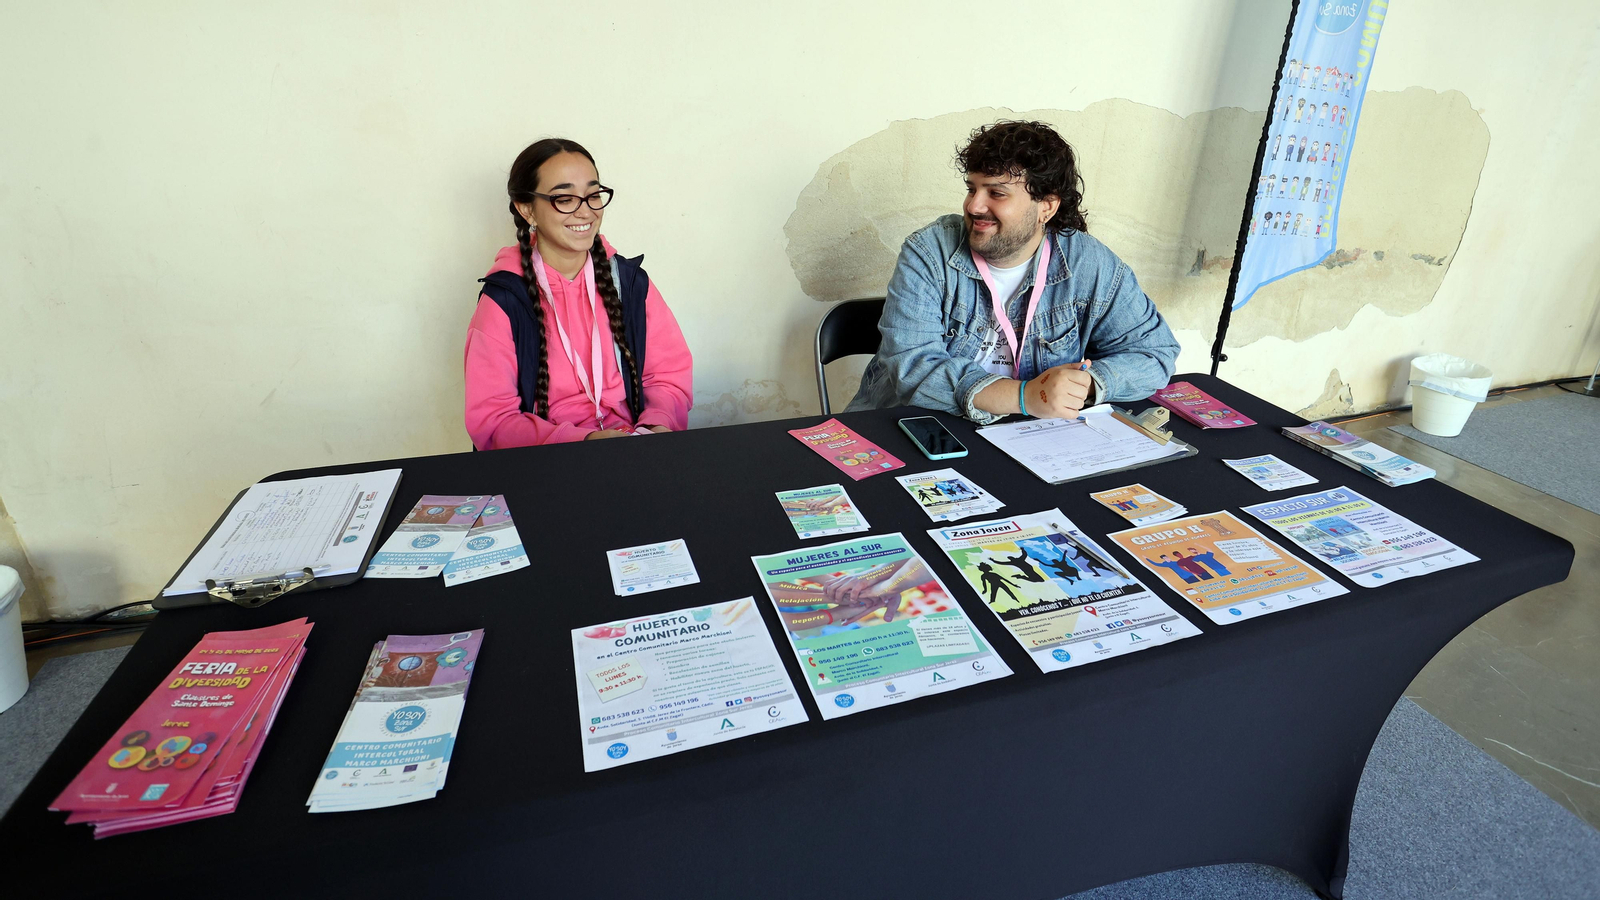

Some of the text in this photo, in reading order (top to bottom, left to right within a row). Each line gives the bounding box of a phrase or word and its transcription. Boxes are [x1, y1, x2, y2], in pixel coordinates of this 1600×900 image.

[1257, 496, 1331, 516] ESPACIO SUR
[1130, 524, 1205, 545] GRUPO H
[787, 551, 839, 566] MUJERES
[861, 543, 882, 552] SUR
[633, 616, 688, 632] HUERTO
[792, 615, 825, 624] Deporte
[615, 623, 710, 647] COMUNITARIO
[639, 641, 678, 651] Comunitario
[701, 630, 732, 639] Marchioni
[827, 642, 852, 651] MARTES
[179, 662, 237, 675] FERIA
[595, 663, 631, 678] TODOS LOS
[604, 671, 627, 682] LUNES
[598, 685, 613, 693] 9:30
[620, 677, 636, 686] 11:30
[393, 711, 424, 720] YO SOY
[161, 719, 190, 727] Jerez
[382, 737, 442, 750] COMUNITARIO
[354, 748, 424, 758] INTERCULTURAL
[379, 754, 430, 766] MARCHIONI
